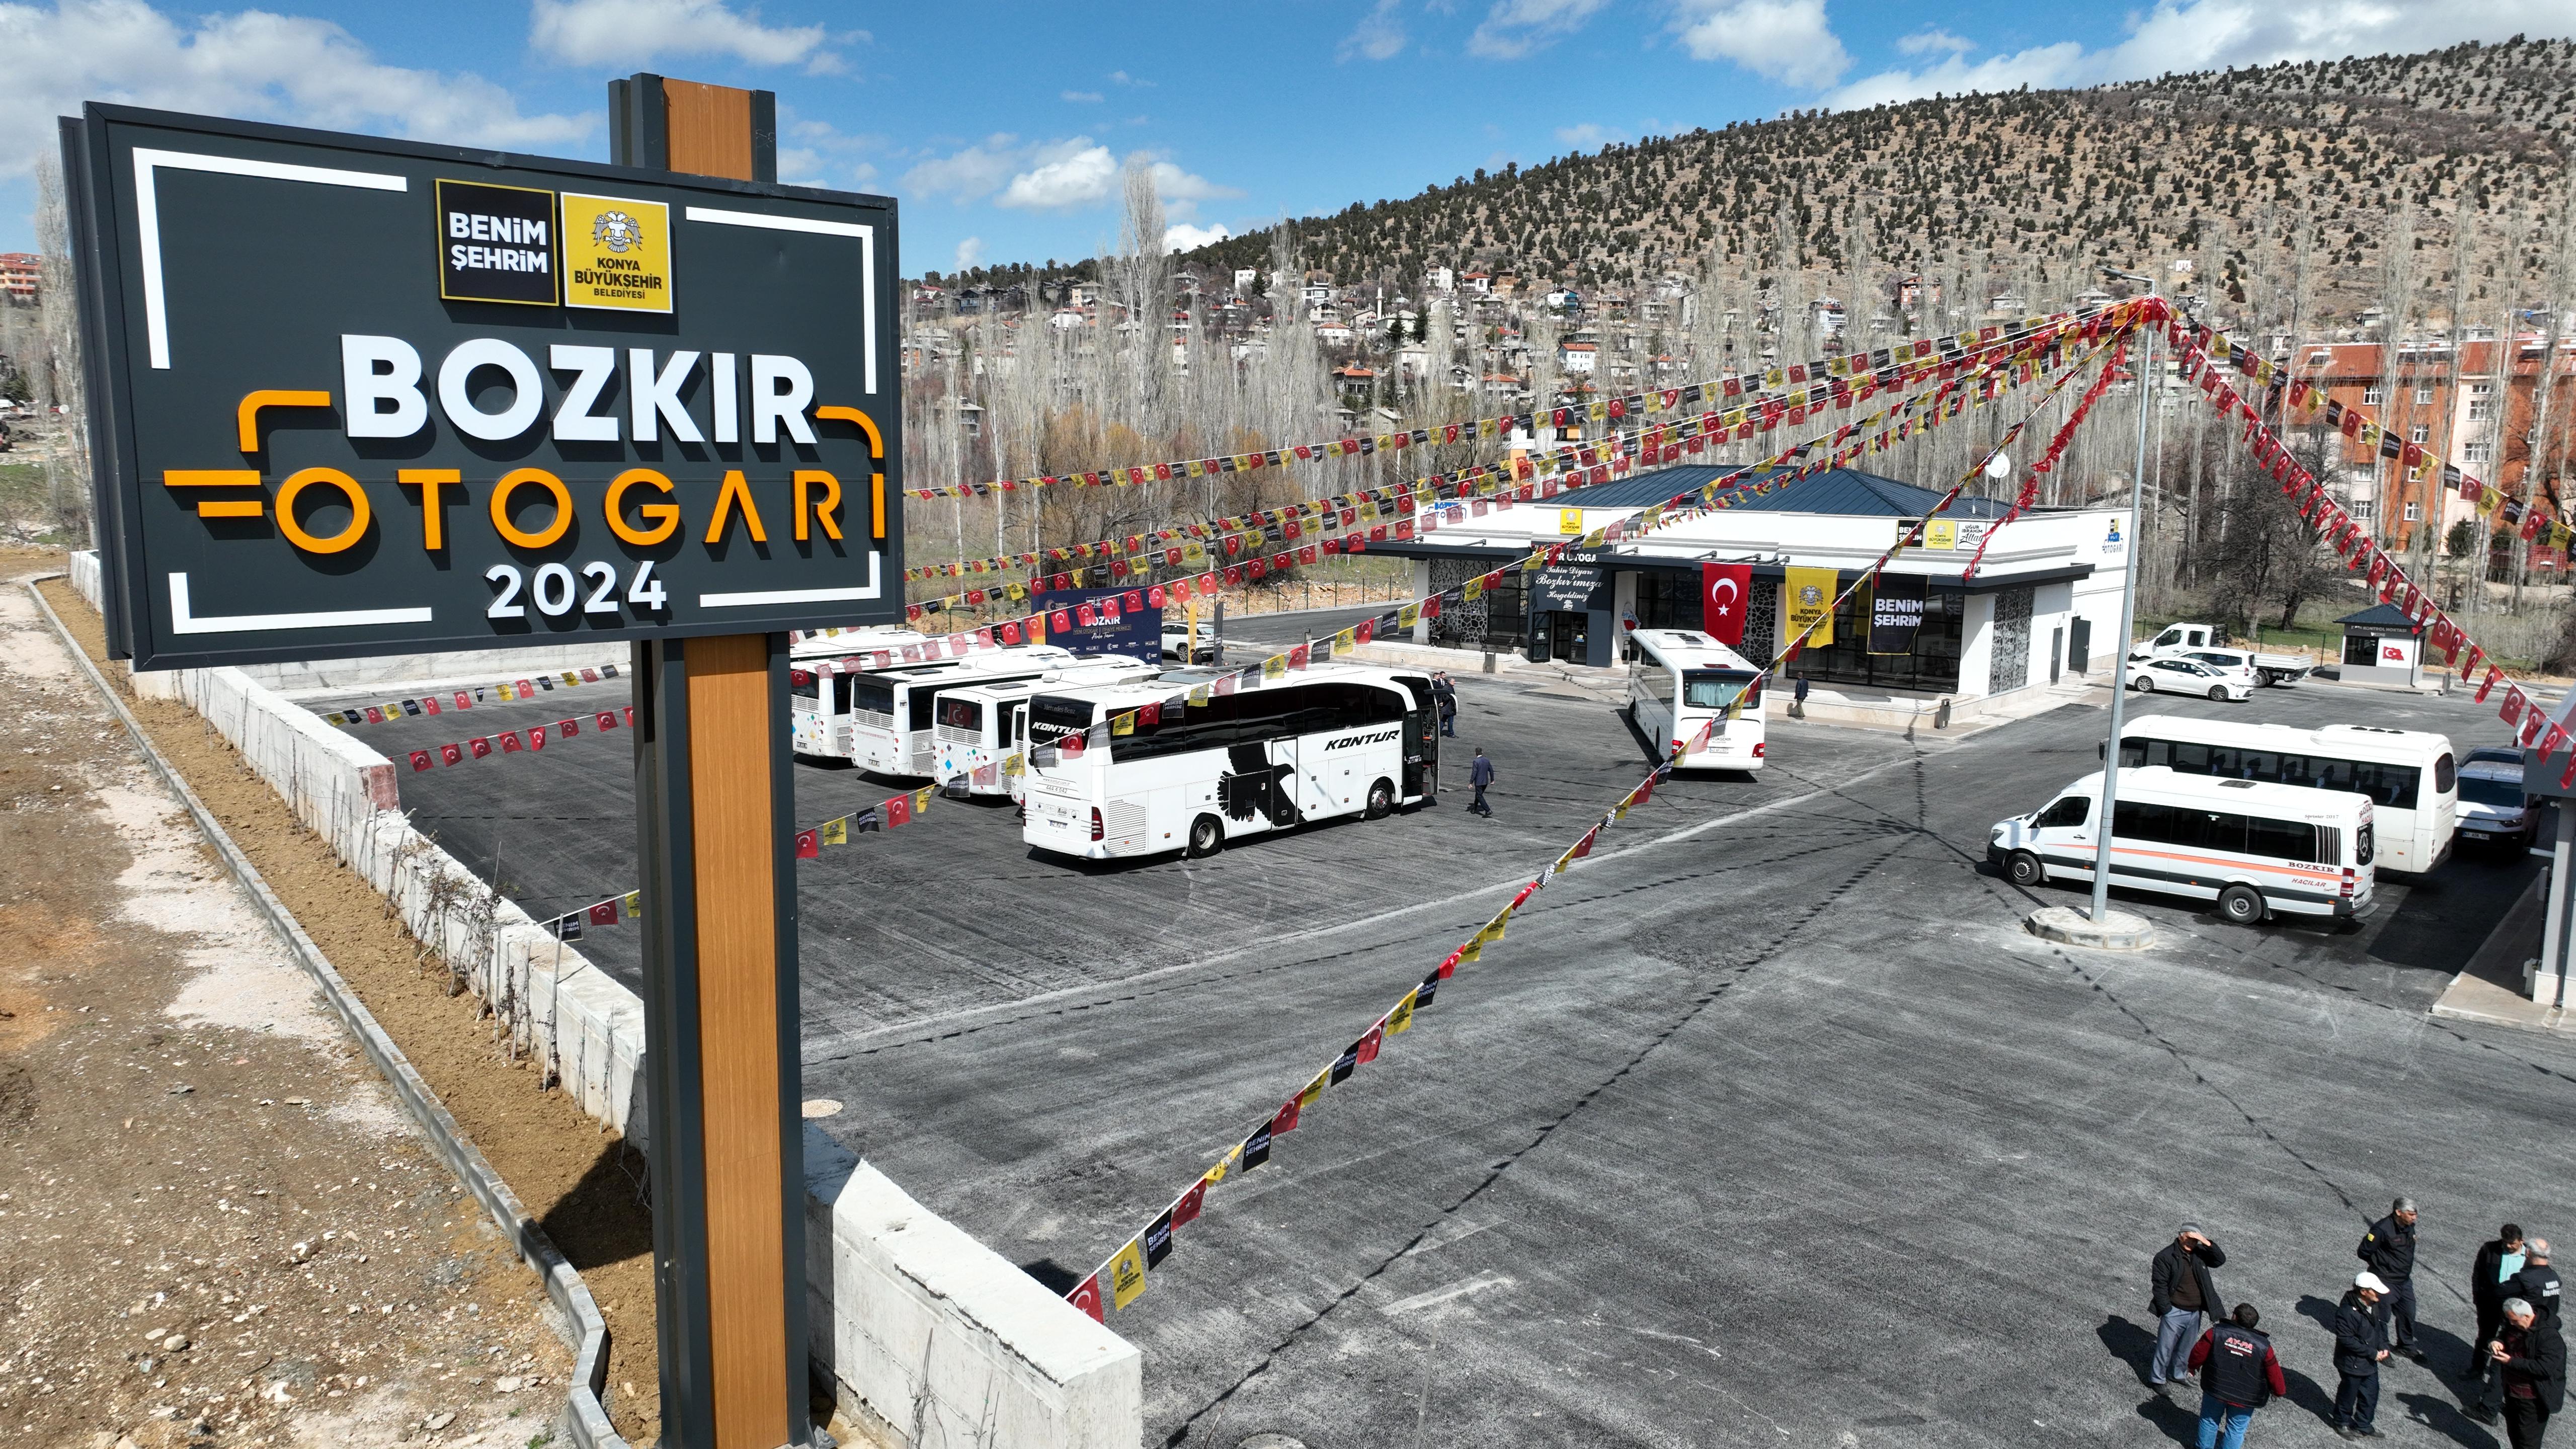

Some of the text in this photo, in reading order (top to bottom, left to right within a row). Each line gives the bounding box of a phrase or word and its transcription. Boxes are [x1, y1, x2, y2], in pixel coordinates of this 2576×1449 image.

[597, 257, 640, 272] KONYA
[575, 269, 662, 290] BÜYÜKŞEHİR
[594, 288, 645, 299] BELEDİYESİ
[341, 334, 817, 444] BOZKIR
[275, 468, 884, 553] OTOGARI
[486, 560, 667, 619] 2024
[1043, 704, 1076, 714] Mercedes-Benz
[1324, 730, 1400, 751] KONTUR
[2288, 861, 2334, 873] BOZKIR
[2291, 878, 2326, 887] HACILAR
